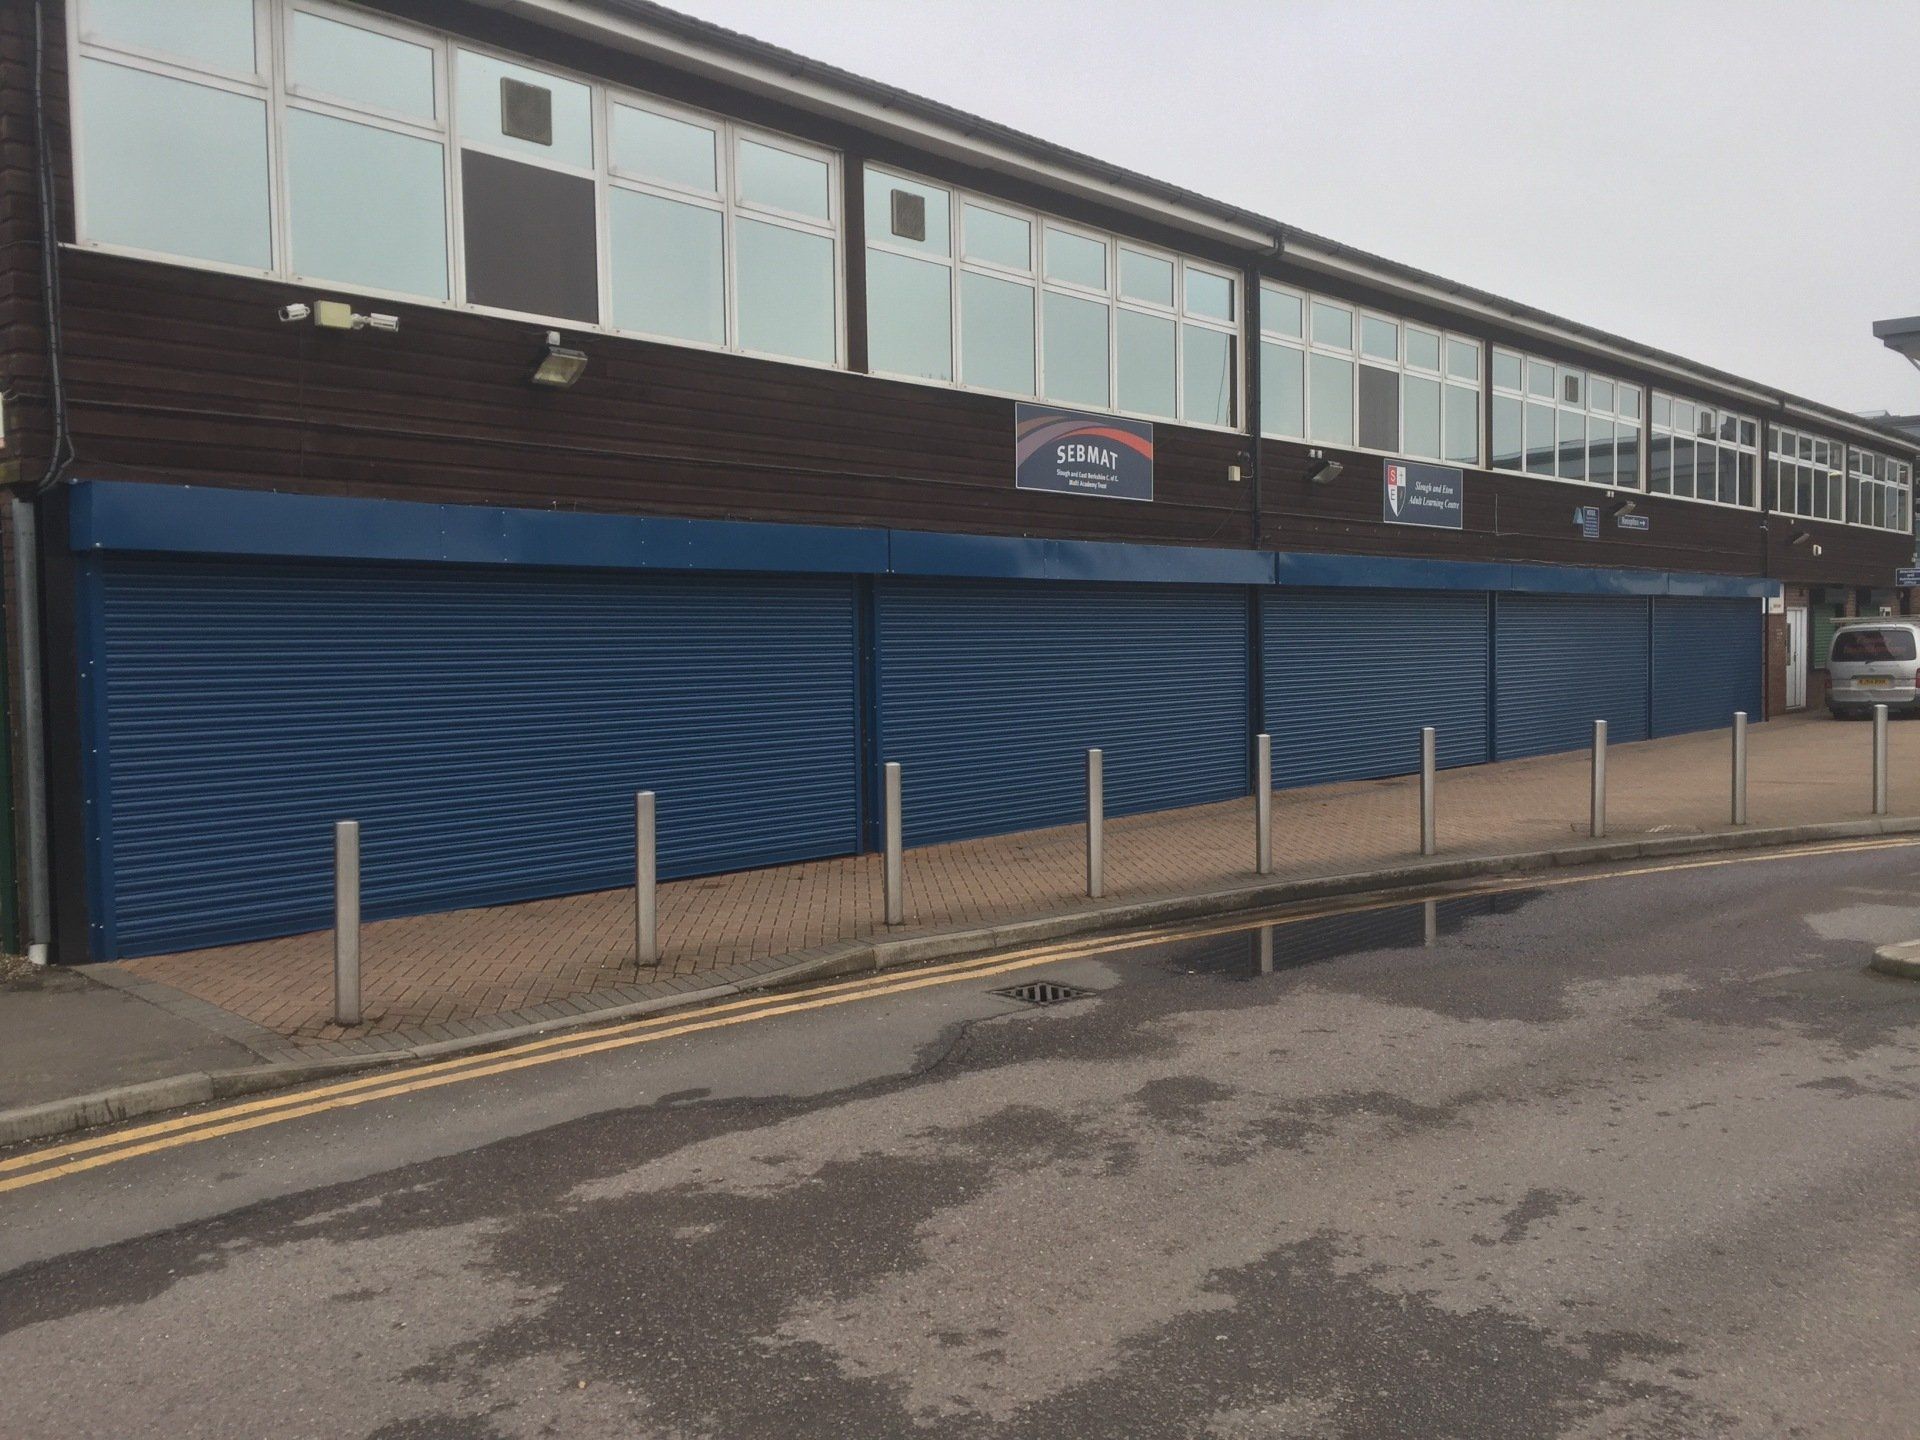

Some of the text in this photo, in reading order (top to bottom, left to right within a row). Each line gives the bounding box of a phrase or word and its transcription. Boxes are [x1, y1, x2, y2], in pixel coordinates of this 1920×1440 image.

[1057, 444, 1118, 470] SEBMAT
[1057, 469, 1070, 478] Slough
[1390, 470, 1396, 482] S
[1080, 481, 1097, 489] Academy
[1415, 481, 1453, 494] Slough and Eton
[1391, 489, 1396, 501] E
[1410, 496, 1422, 505] Adult
[1423, 497, 1443, 509] Learning
